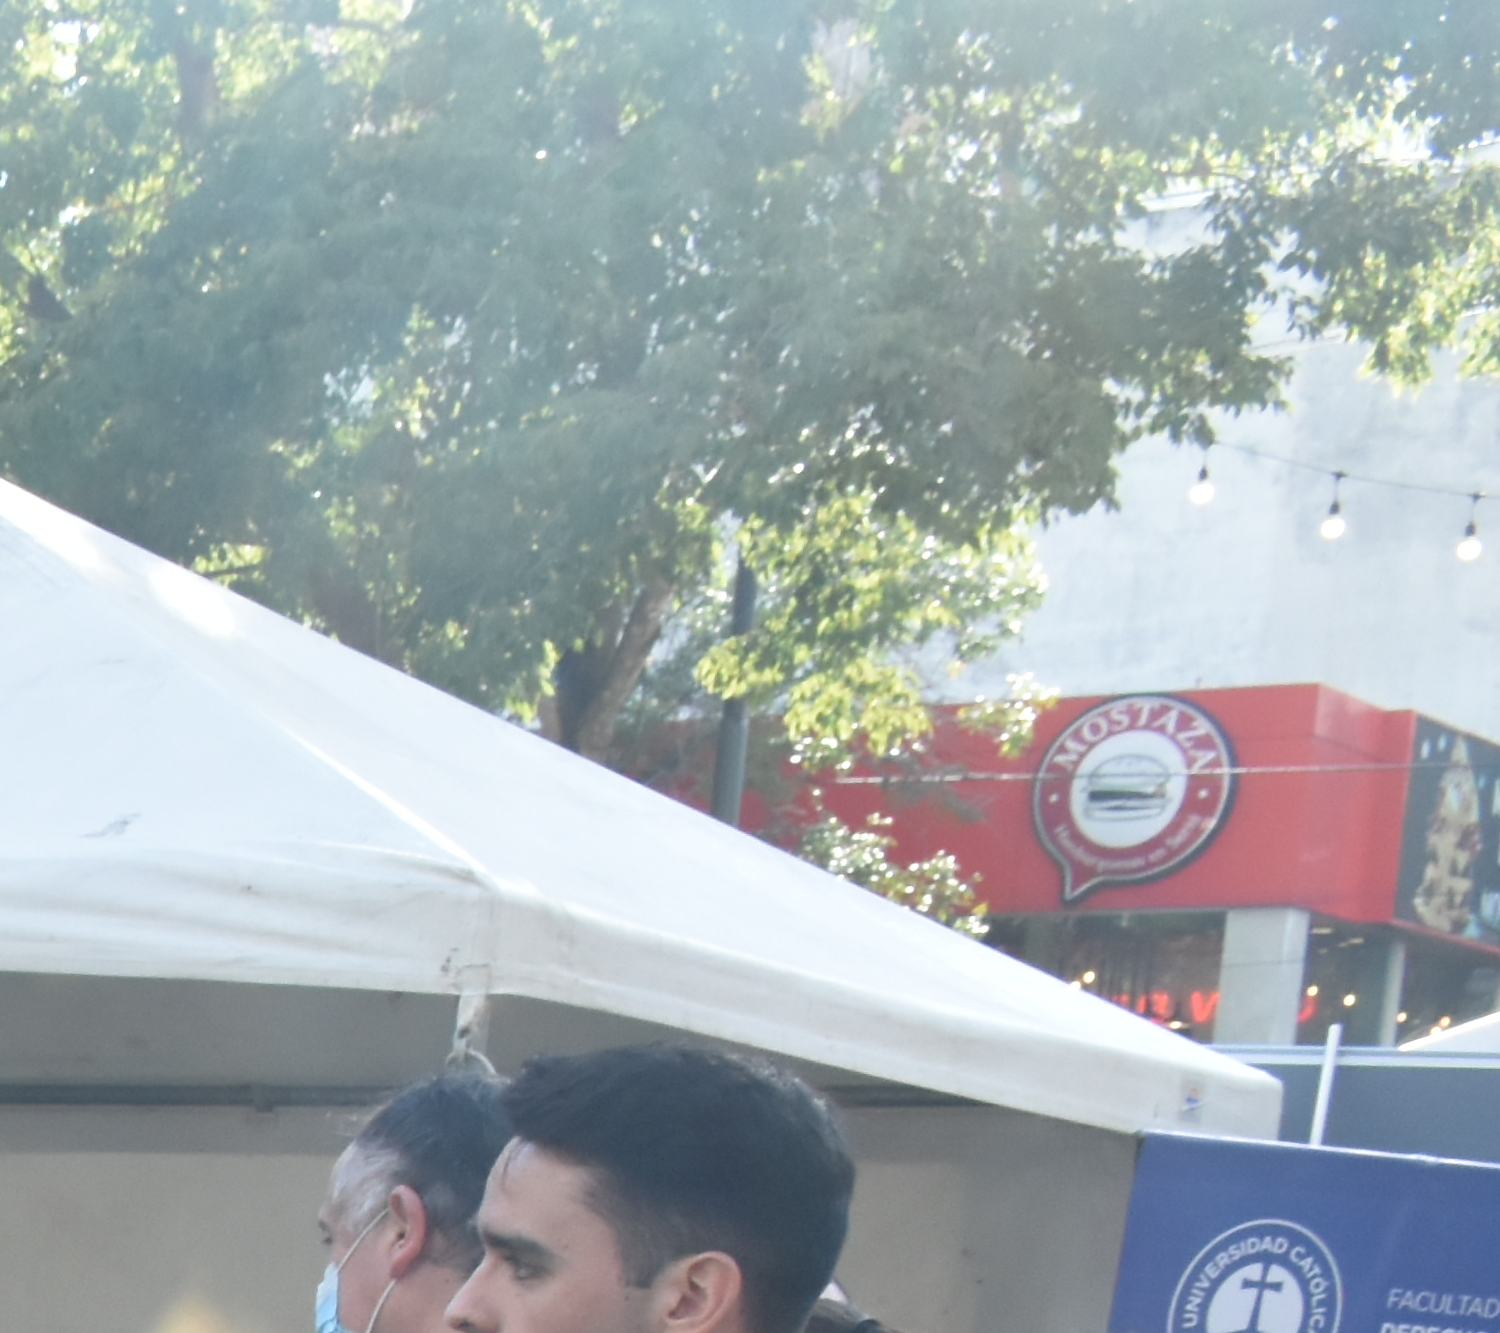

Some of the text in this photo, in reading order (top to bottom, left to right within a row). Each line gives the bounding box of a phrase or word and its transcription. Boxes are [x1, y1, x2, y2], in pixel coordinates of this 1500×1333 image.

[1053, 702, 1218, 775] MOSTAZA
[1182, 1236, 1288, 1329] UNIVERSIDAD
[1386, 1287, 1500, 1319] FACULTAD
